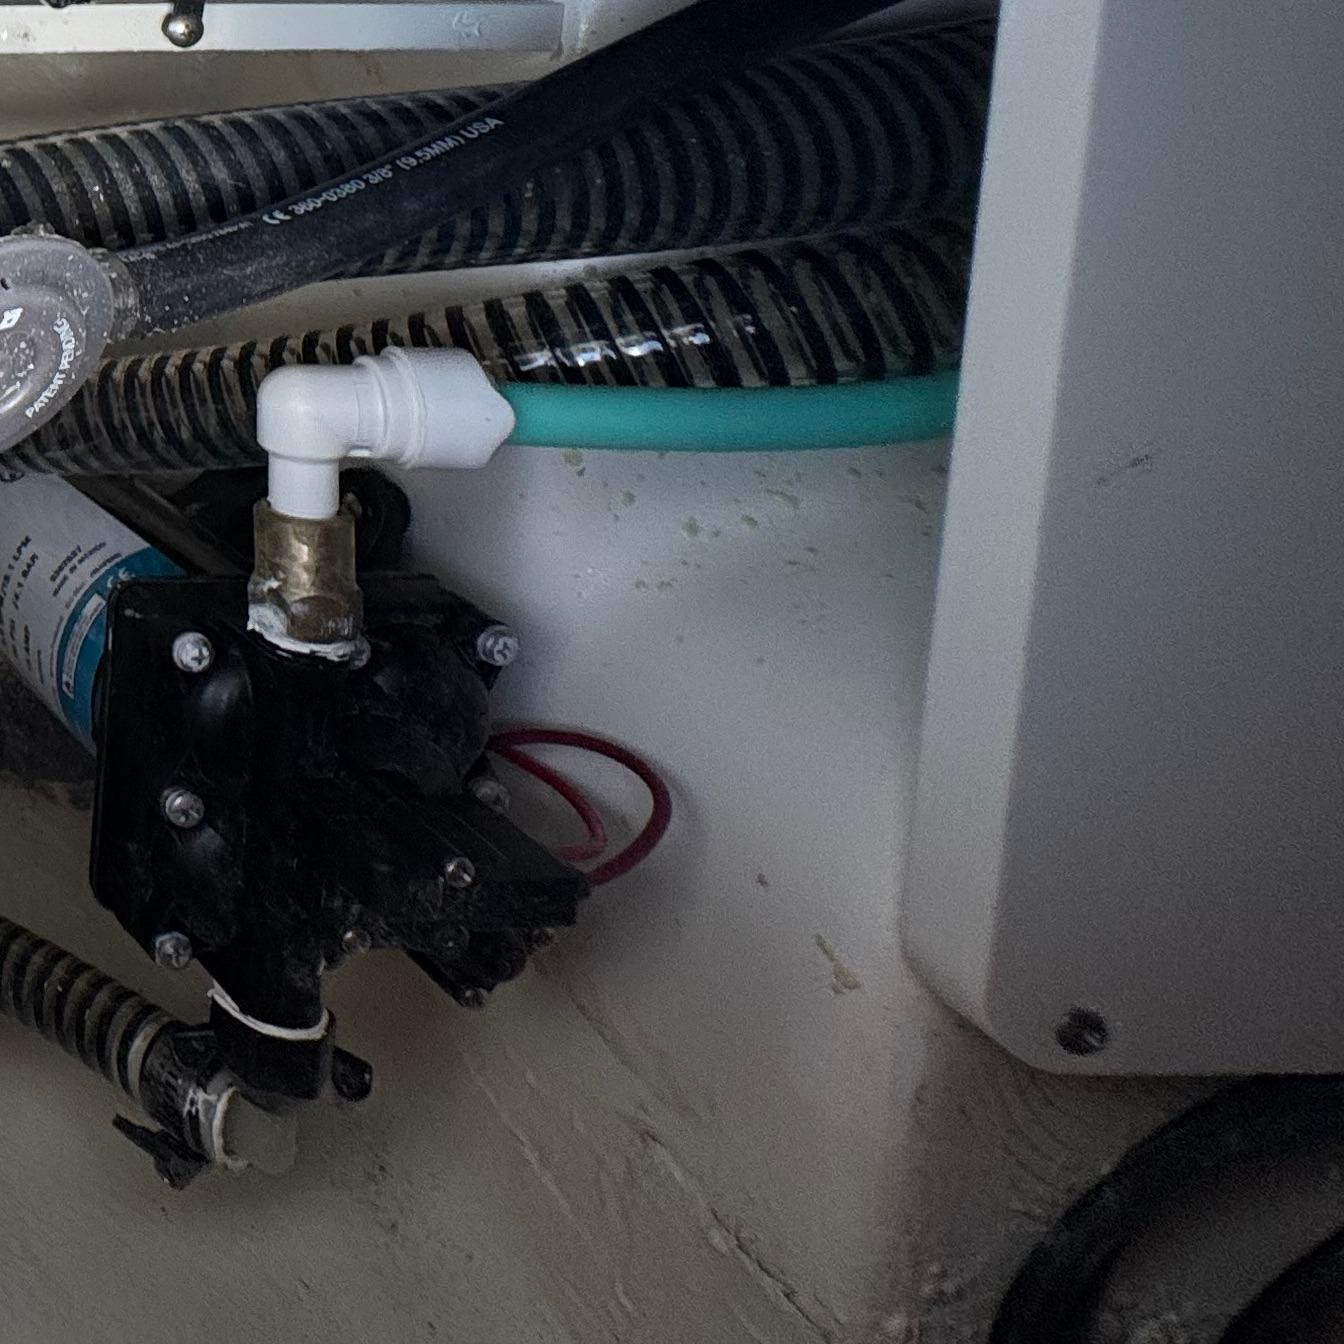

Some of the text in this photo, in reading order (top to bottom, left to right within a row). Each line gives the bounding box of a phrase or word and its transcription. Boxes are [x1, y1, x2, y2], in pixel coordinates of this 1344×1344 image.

[397, 135, 463, 171] (9.5MM)
[461, 117, 504, 140] USA
[25, 372, 67, 419] PATENT
